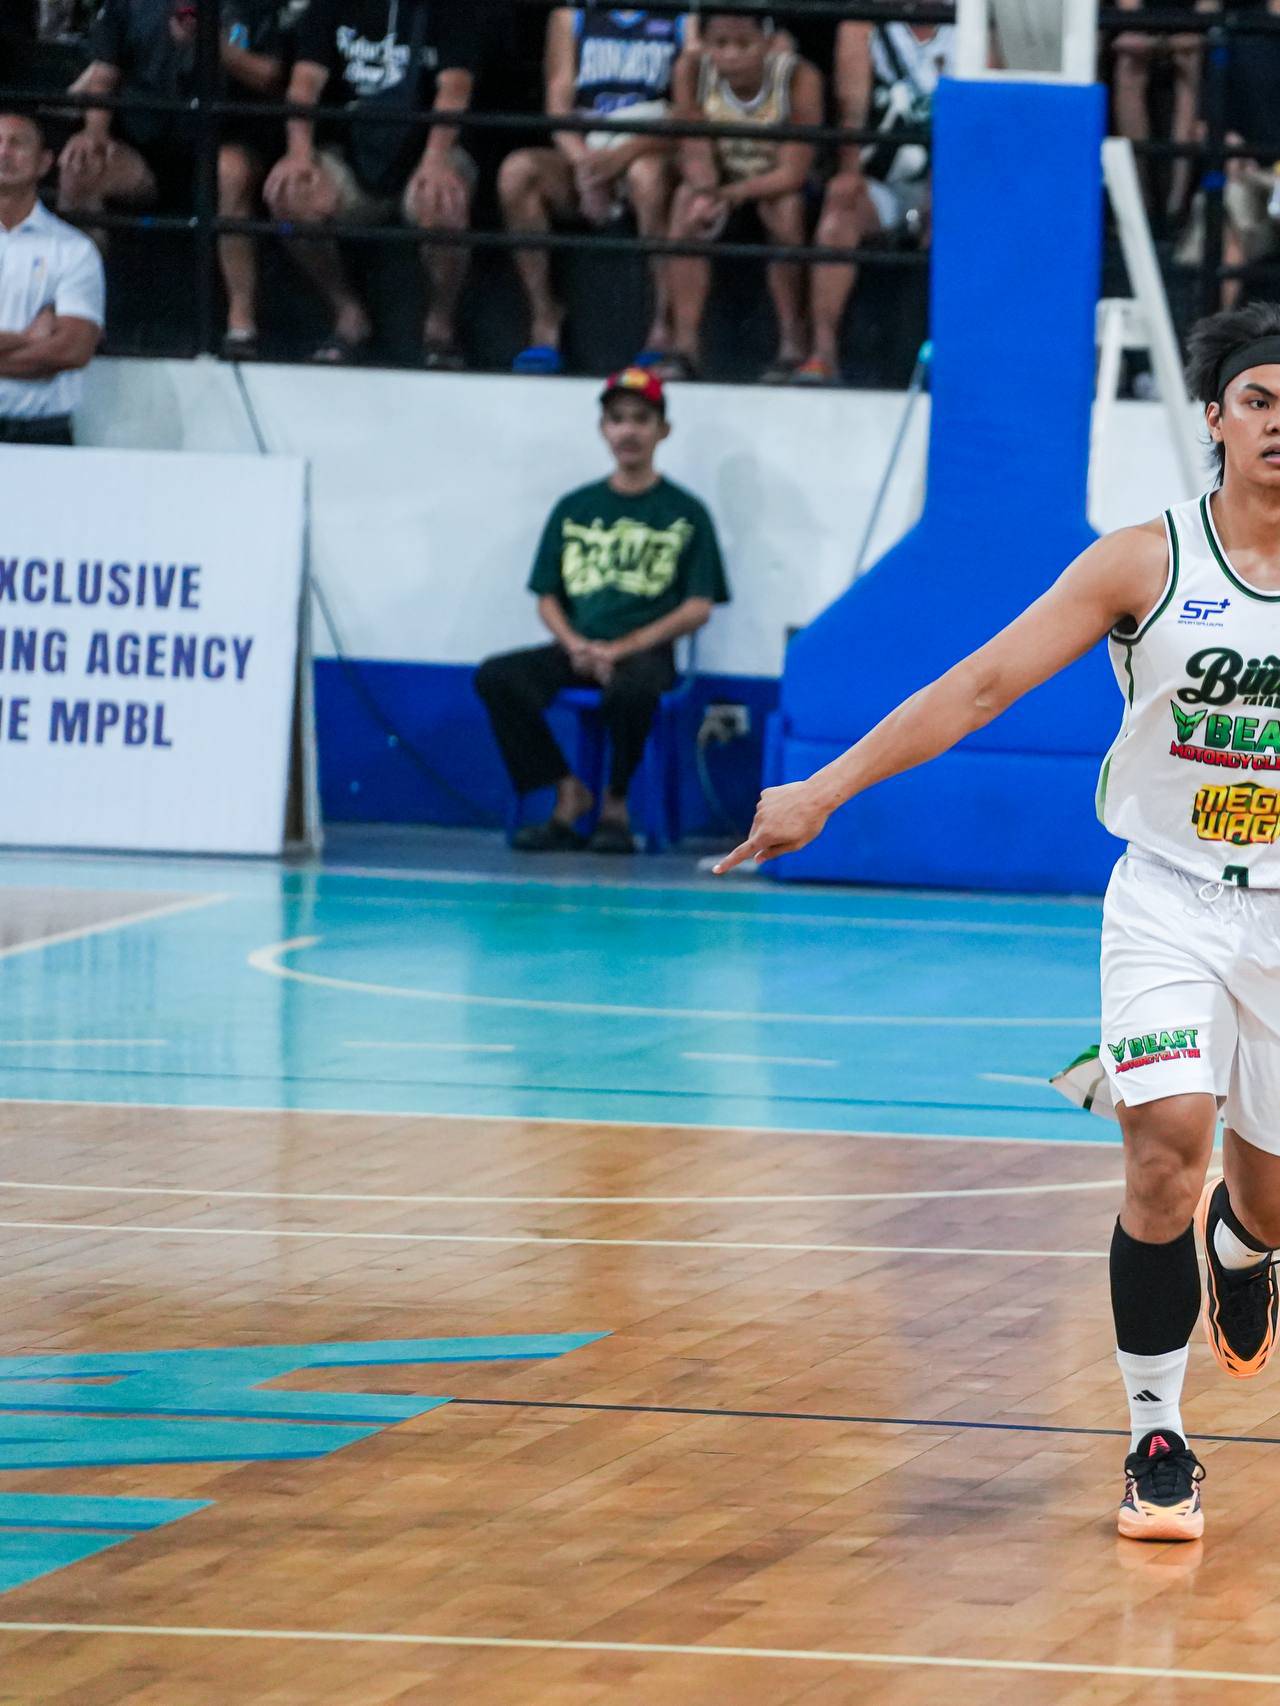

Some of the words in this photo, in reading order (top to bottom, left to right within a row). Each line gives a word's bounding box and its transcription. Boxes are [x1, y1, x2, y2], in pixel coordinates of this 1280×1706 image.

[86, 631, 254, 681] AGENCY
[49, 698, 172, 747] MPBL
[1128, 1029, 1198, 1058] BEAST
